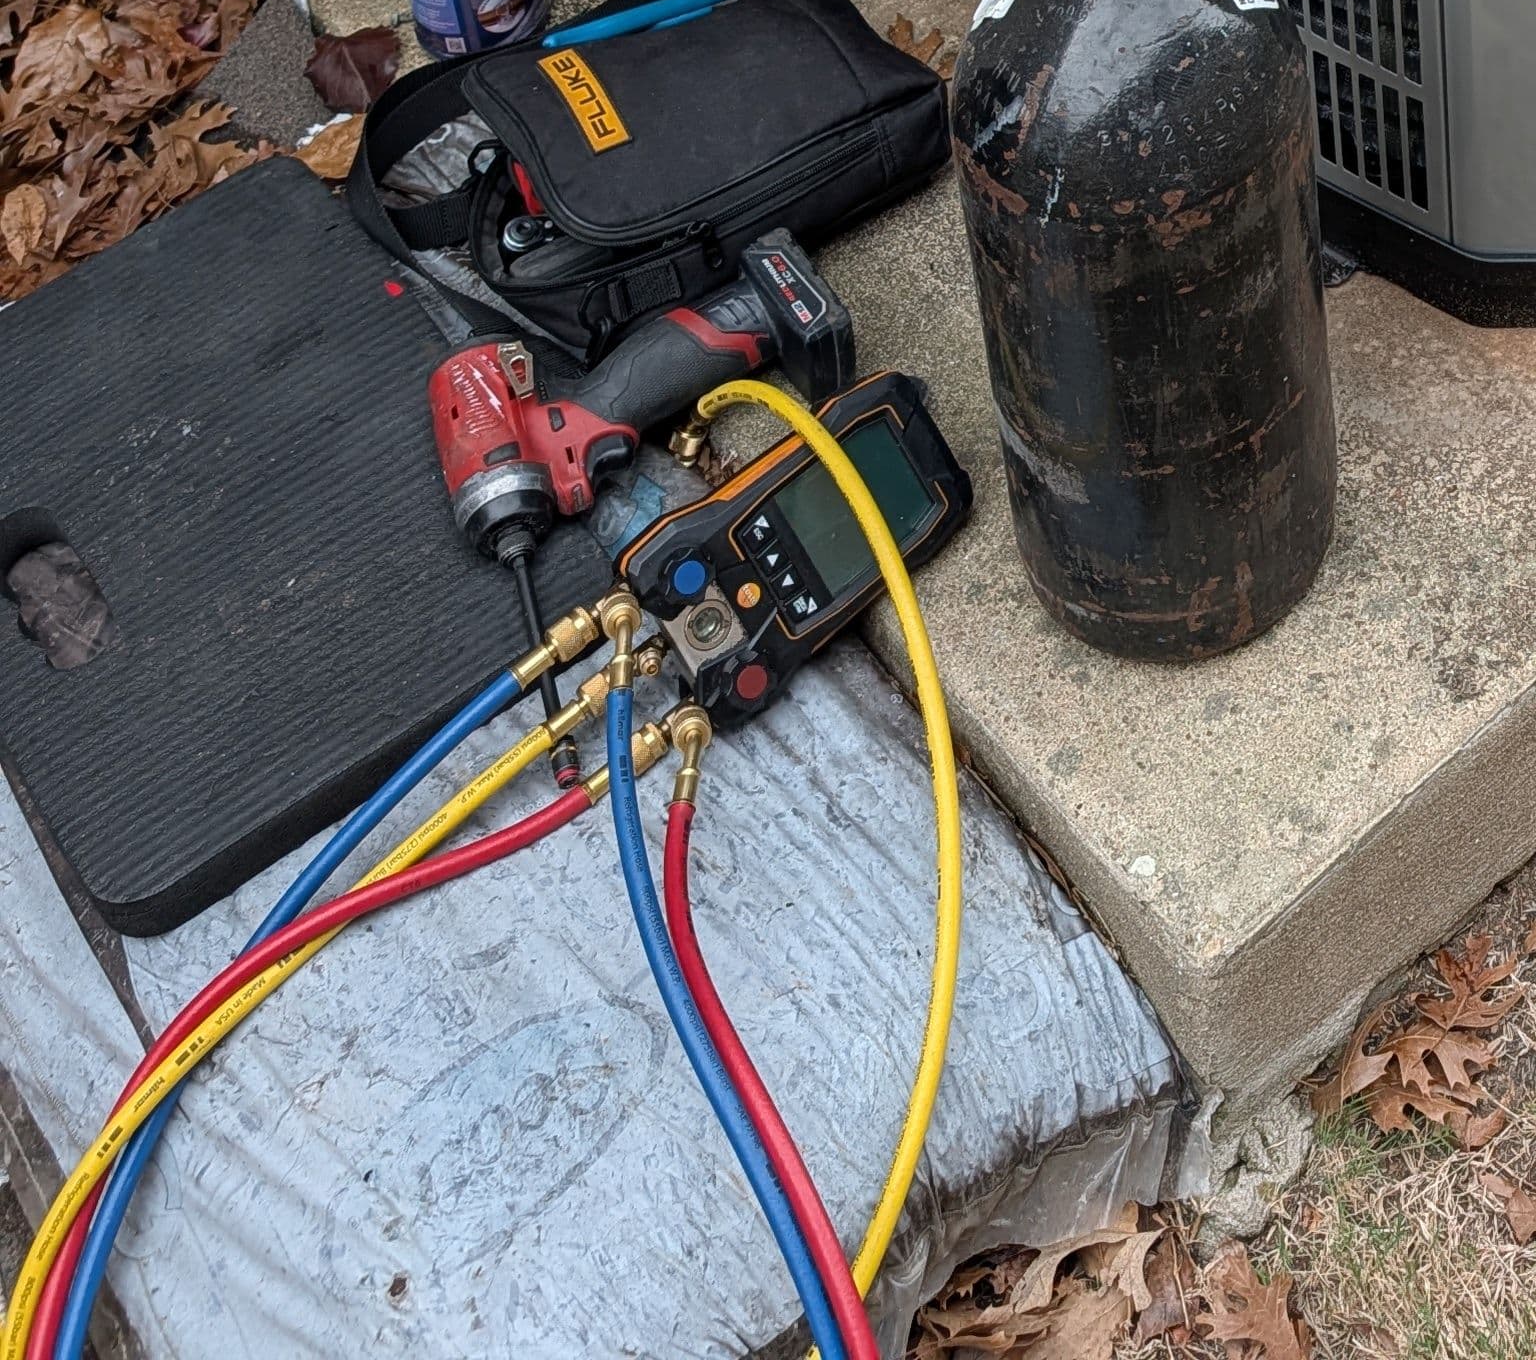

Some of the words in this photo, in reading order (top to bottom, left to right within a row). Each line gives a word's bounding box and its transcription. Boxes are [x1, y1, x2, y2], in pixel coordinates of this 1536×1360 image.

[551, 55, 617, 139] FLUKE
[450, 363, 500, 437] Milwaukee
[418, 811, 448, 841] 4000psi
[386, 838, 419, 870] (275bar)
[243, 975, 268, 1003] Made
[216, 1008, 236, 1028] USA
[233, 999, 244, 1010] in
